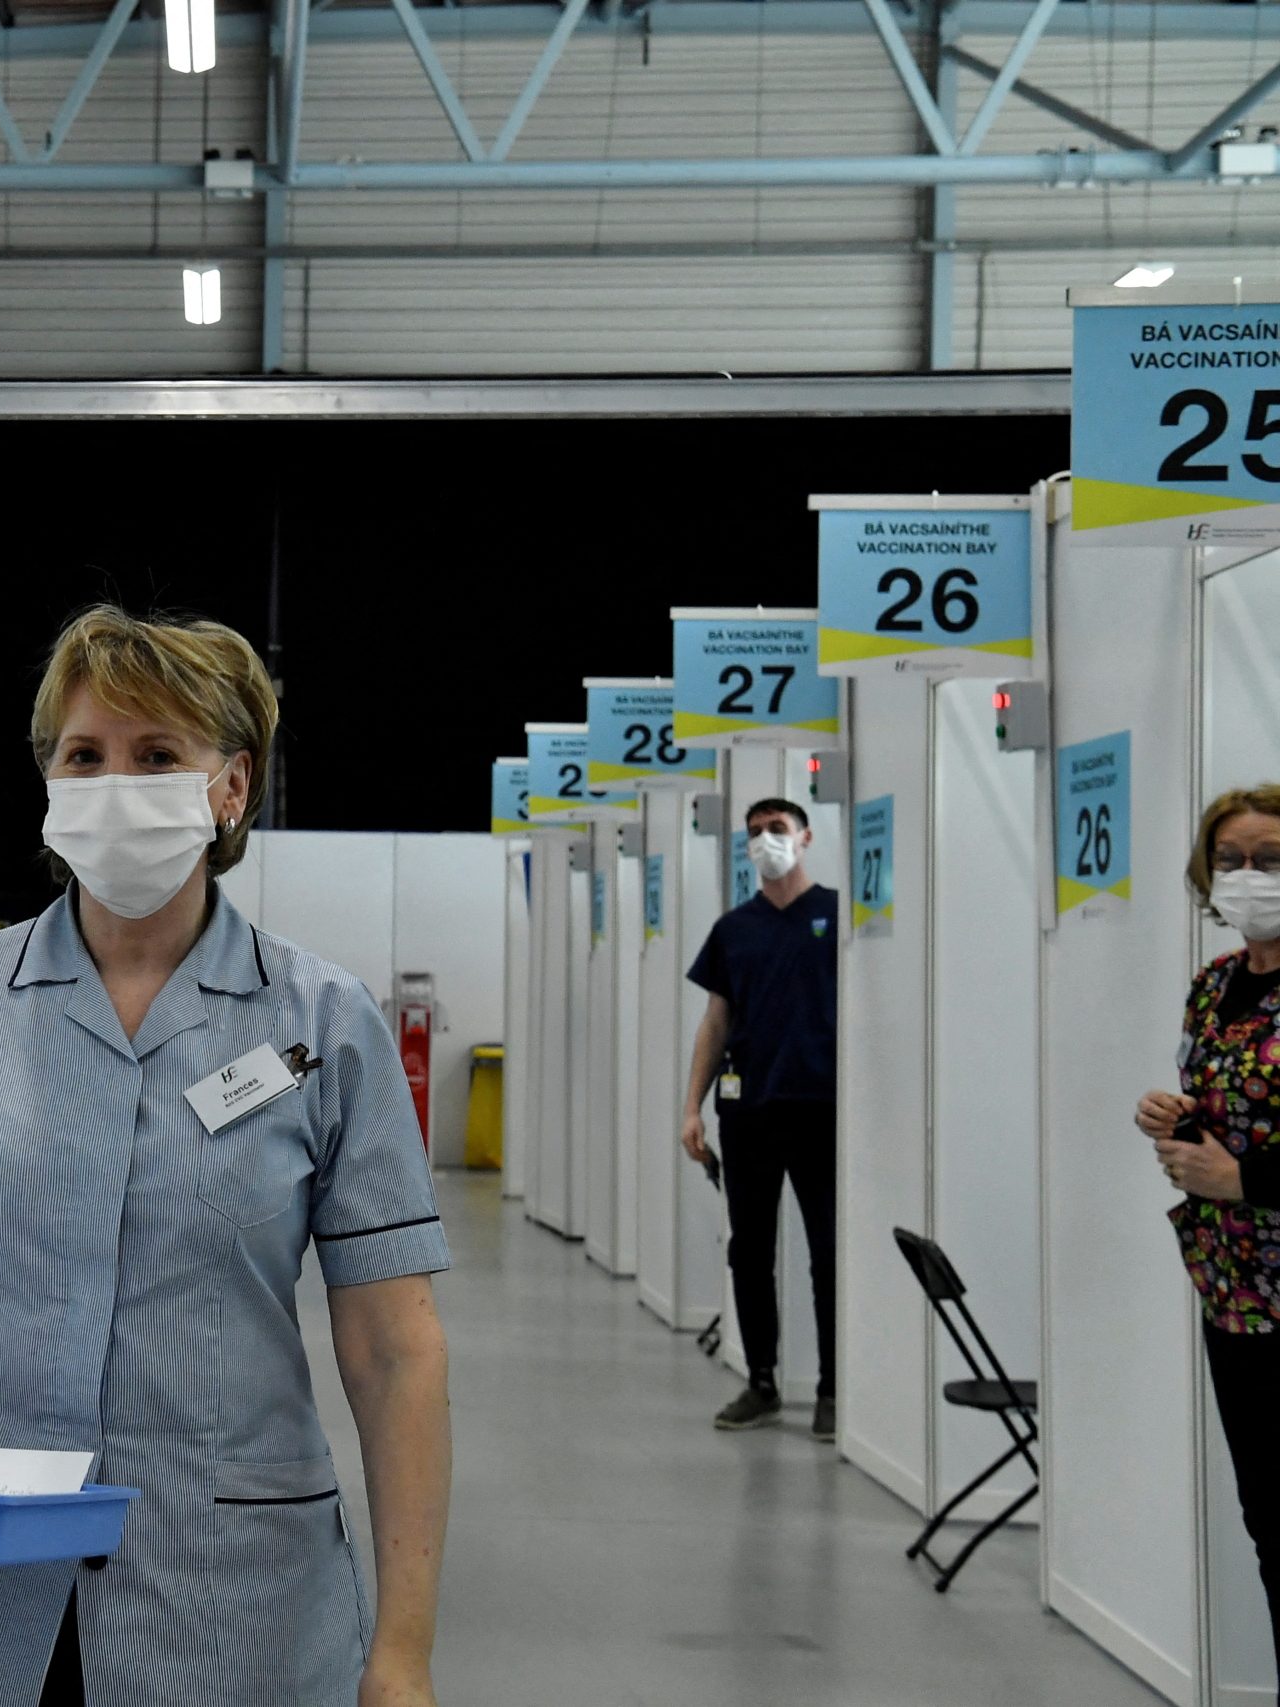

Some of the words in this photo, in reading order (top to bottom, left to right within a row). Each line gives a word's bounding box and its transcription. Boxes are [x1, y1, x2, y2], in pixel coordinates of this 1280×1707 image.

[1141, 321, 1171, 342] BÁ
[1157, 388, 1280, 483] 25
[857, 542, 962, 554] VACCINATION
[966, 542, 997, 555] BAY
[864, 521, 885, 537] BÁ
[889, 520, 990, 537] VACSAÍNÍTHE
[875, 567, 979, 633] 26
[703, 644, 783, 655] VACCINATION
[785, 645, 810, 655] BAY
[717, 665, 795, 714] 27
[623, 724, 687, 764] 28
[1076, 803, 1112, 877] 26
[863, 848, 882, 902] 27
[222, 1077, 259, 1101] Frances
